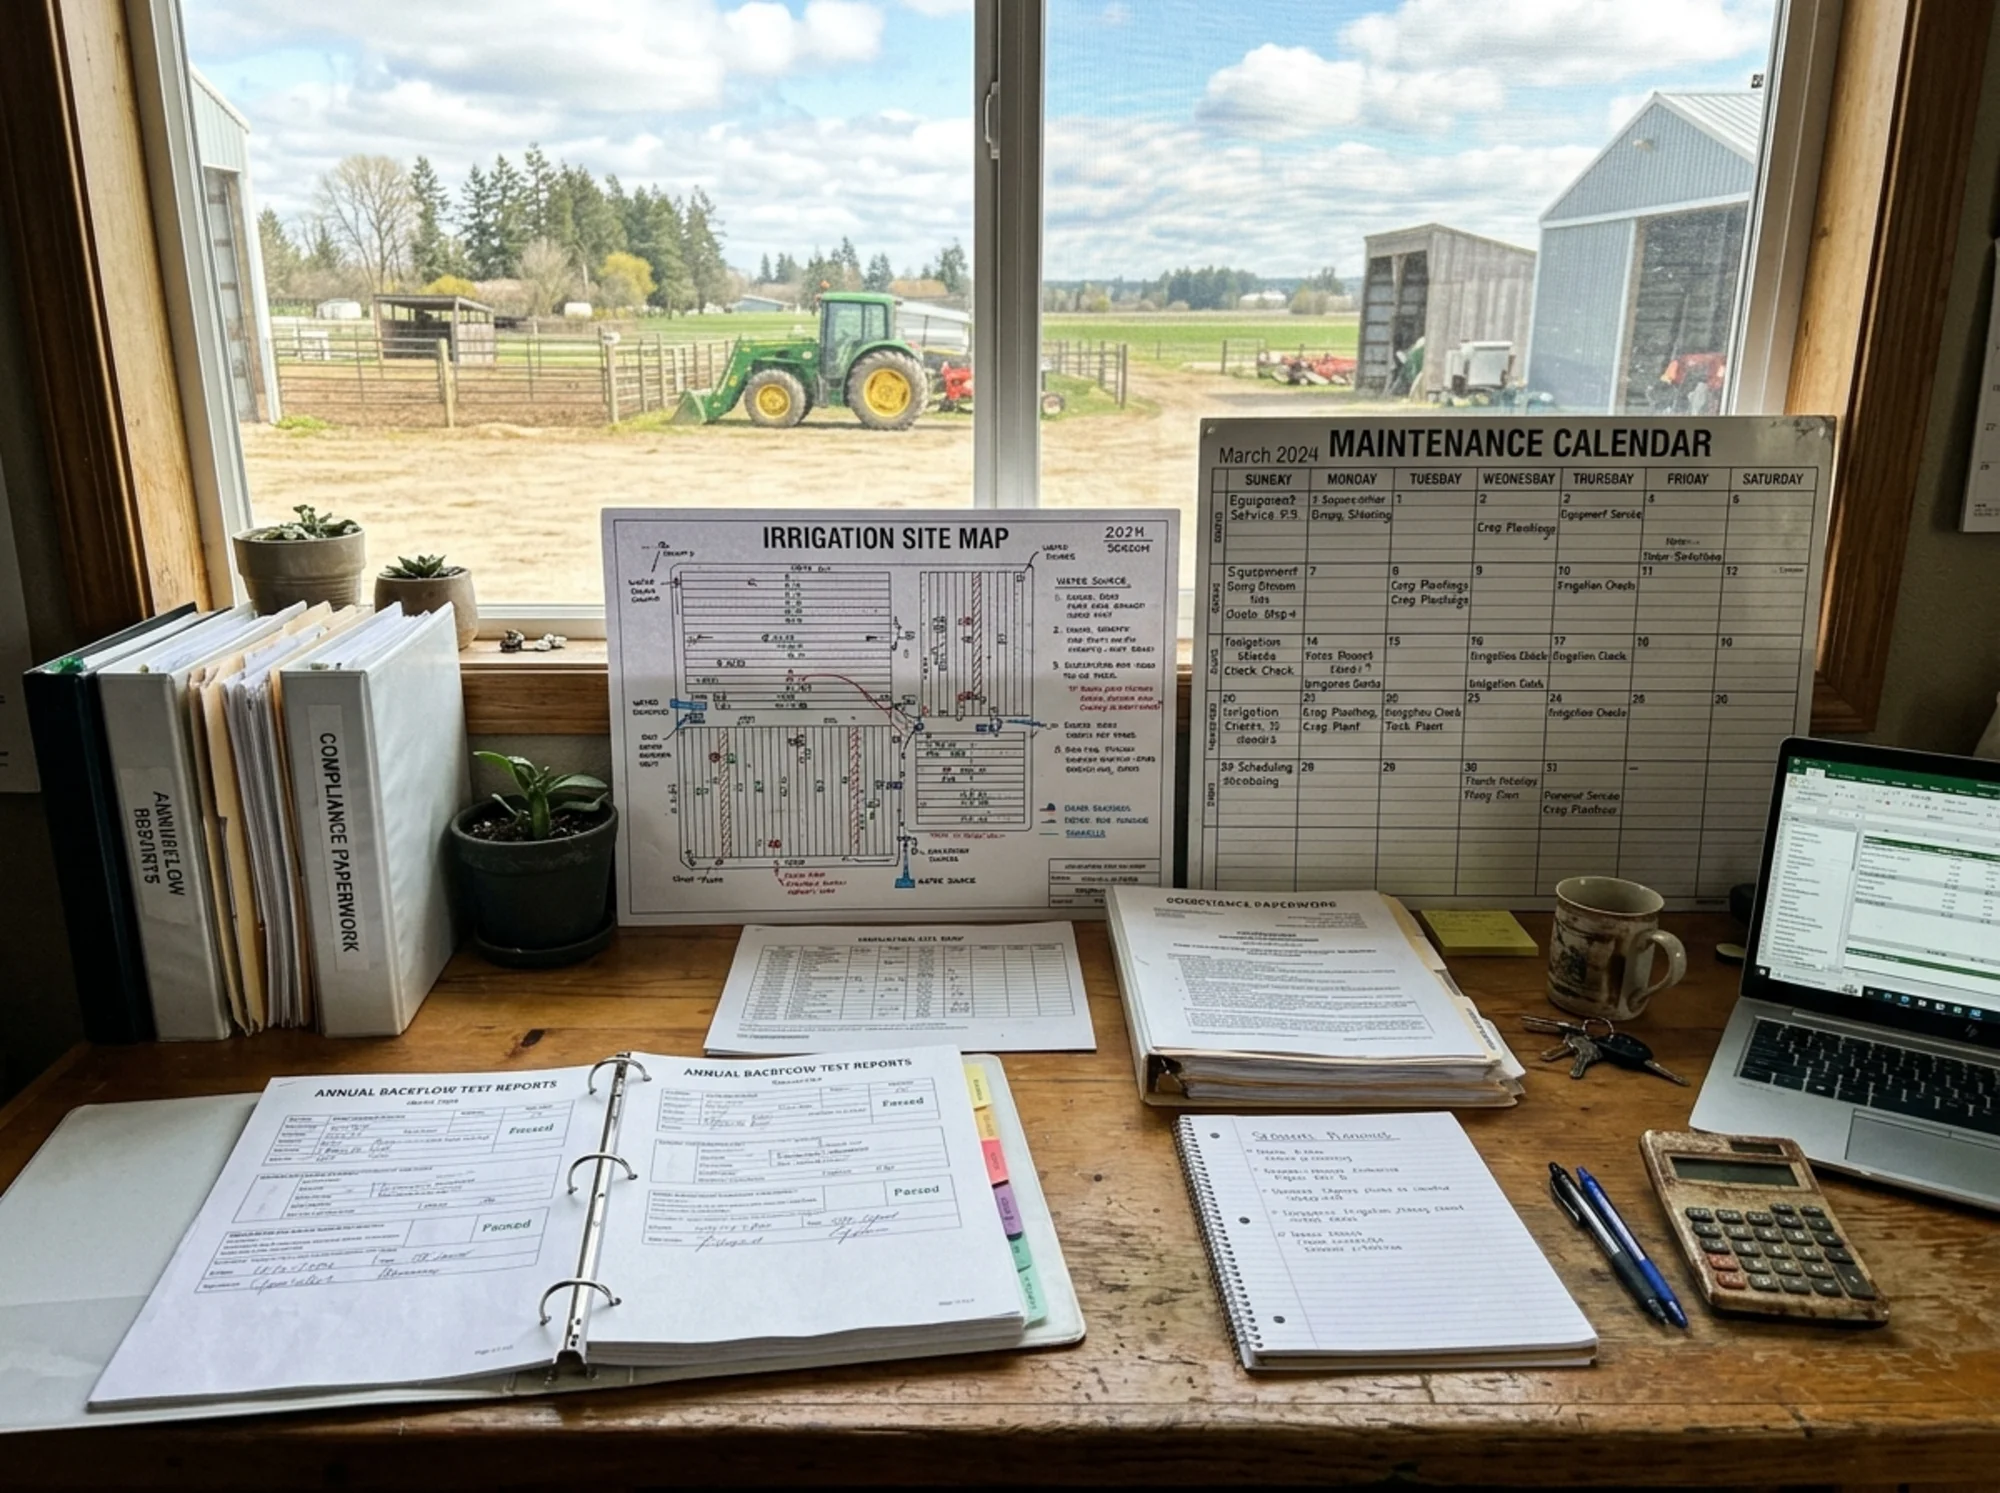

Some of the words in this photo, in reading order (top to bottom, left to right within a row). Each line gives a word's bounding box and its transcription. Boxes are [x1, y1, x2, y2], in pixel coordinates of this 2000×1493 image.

[1330, 429, 1544, 457] MAINTENANCE
[1553, 429, 1712, 457] CALENDAR
[1219, 448, 1271, 464] March
[1276, 446, 1319, 462] 2024
[1743, 473, 1803, 485] SATURDAY
[1480, 494, 1487, 503] 2
[1564, 494, 1570, 503] 2
[763, 526, 894, 549] IRRIGATION
[903, 527, 951, 549] SITE
[959, 527, 1009, 549] MAP
[1310, 567, 1316, 575] 7
[1468, 693, 1480, 702] 25
[332, 849, 360, 953] PAPERWORK
[683, 1068, 740, 1077] ANNUAL
[820, 1063, 849, 1073] TEST
[854, 1058, 912, 1069] REPORTS
[314, 1088, 376, 1097] ANNUAL
